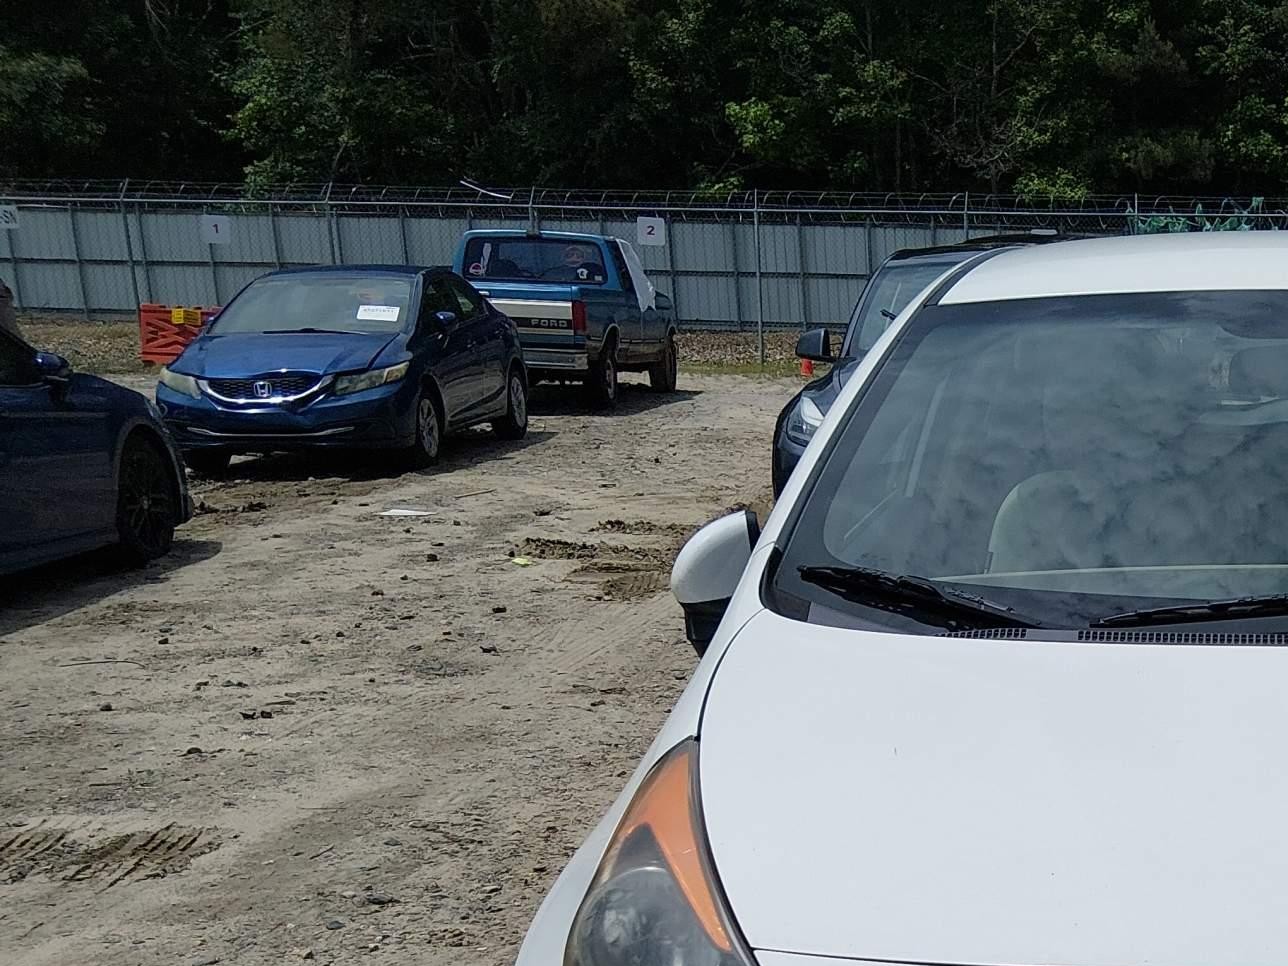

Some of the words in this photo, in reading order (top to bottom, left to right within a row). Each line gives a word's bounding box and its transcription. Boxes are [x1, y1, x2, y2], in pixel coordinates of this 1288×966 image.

[212, 223, 220, 234] 1
[646, 225, 656, 236] 2
[531, 318, 568, 328] FORD
